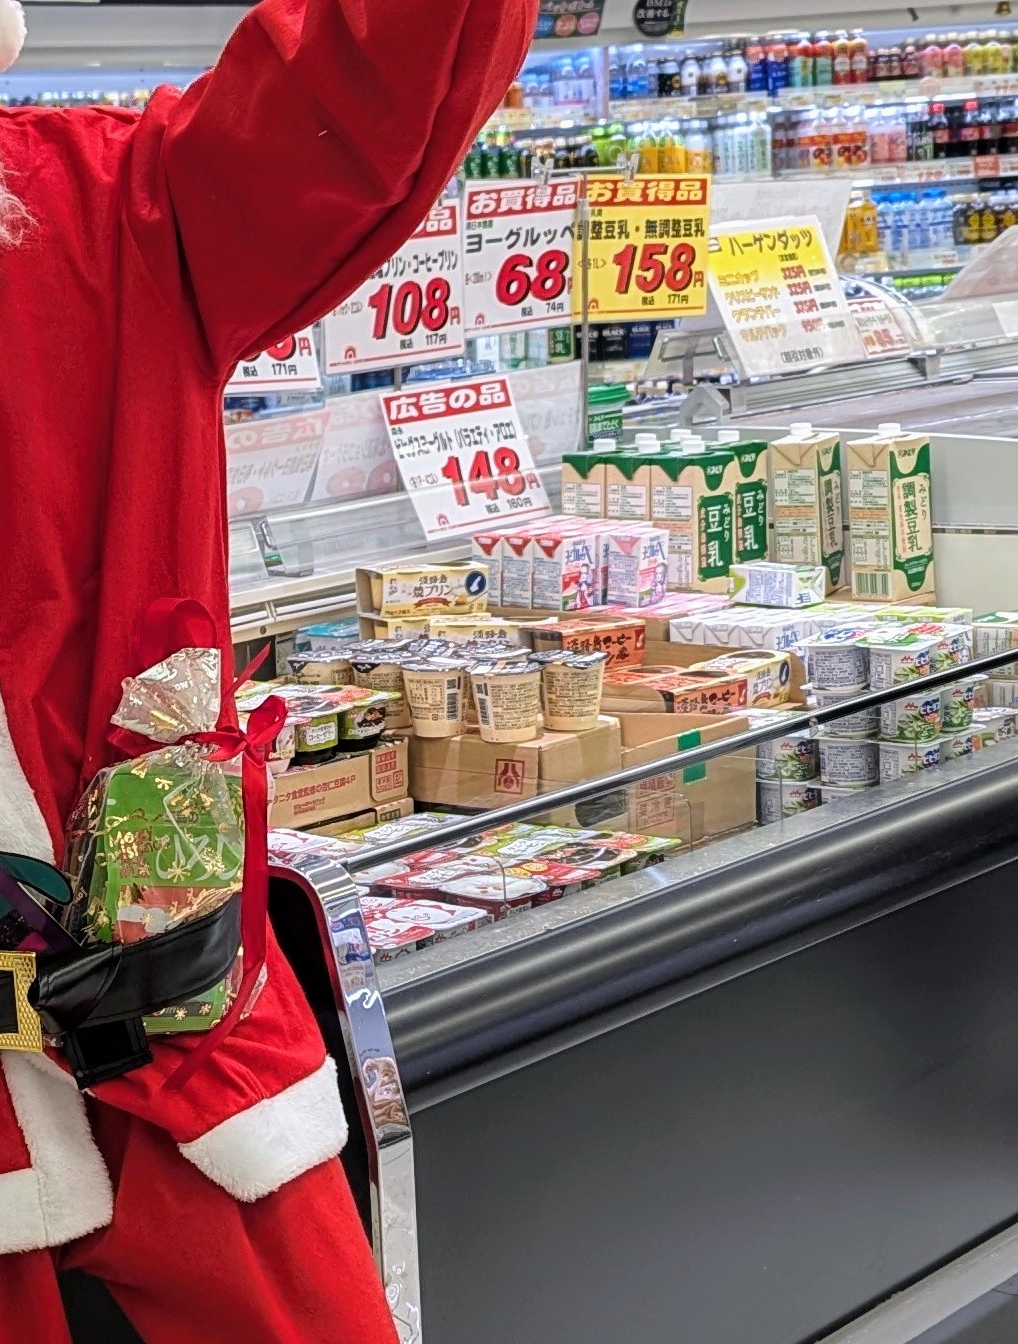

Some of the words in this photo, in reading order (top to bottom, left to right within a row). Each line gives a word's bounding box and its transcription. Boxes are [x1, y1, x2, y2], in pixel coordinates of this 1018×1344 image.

[470, 184, 577, 215] お買得品
[586, 180, 703, 203] お買得品
[612, 242, 697, 295] 158
[728, 229, 813, 257] ハーゲンダッツ
[495, 249, 570, 307] 68
[368, 277, 451, 341] 108
[271, 363, 298, 377] 171円
[389, 381, 506, 421] 広告の品
[440, 446, 526, 507] 148
[707, 504, 724, 568] 豆乳
[742, 490, 759, 551] 豆乳
[902, 481, 923, 553] 調製豆乳
